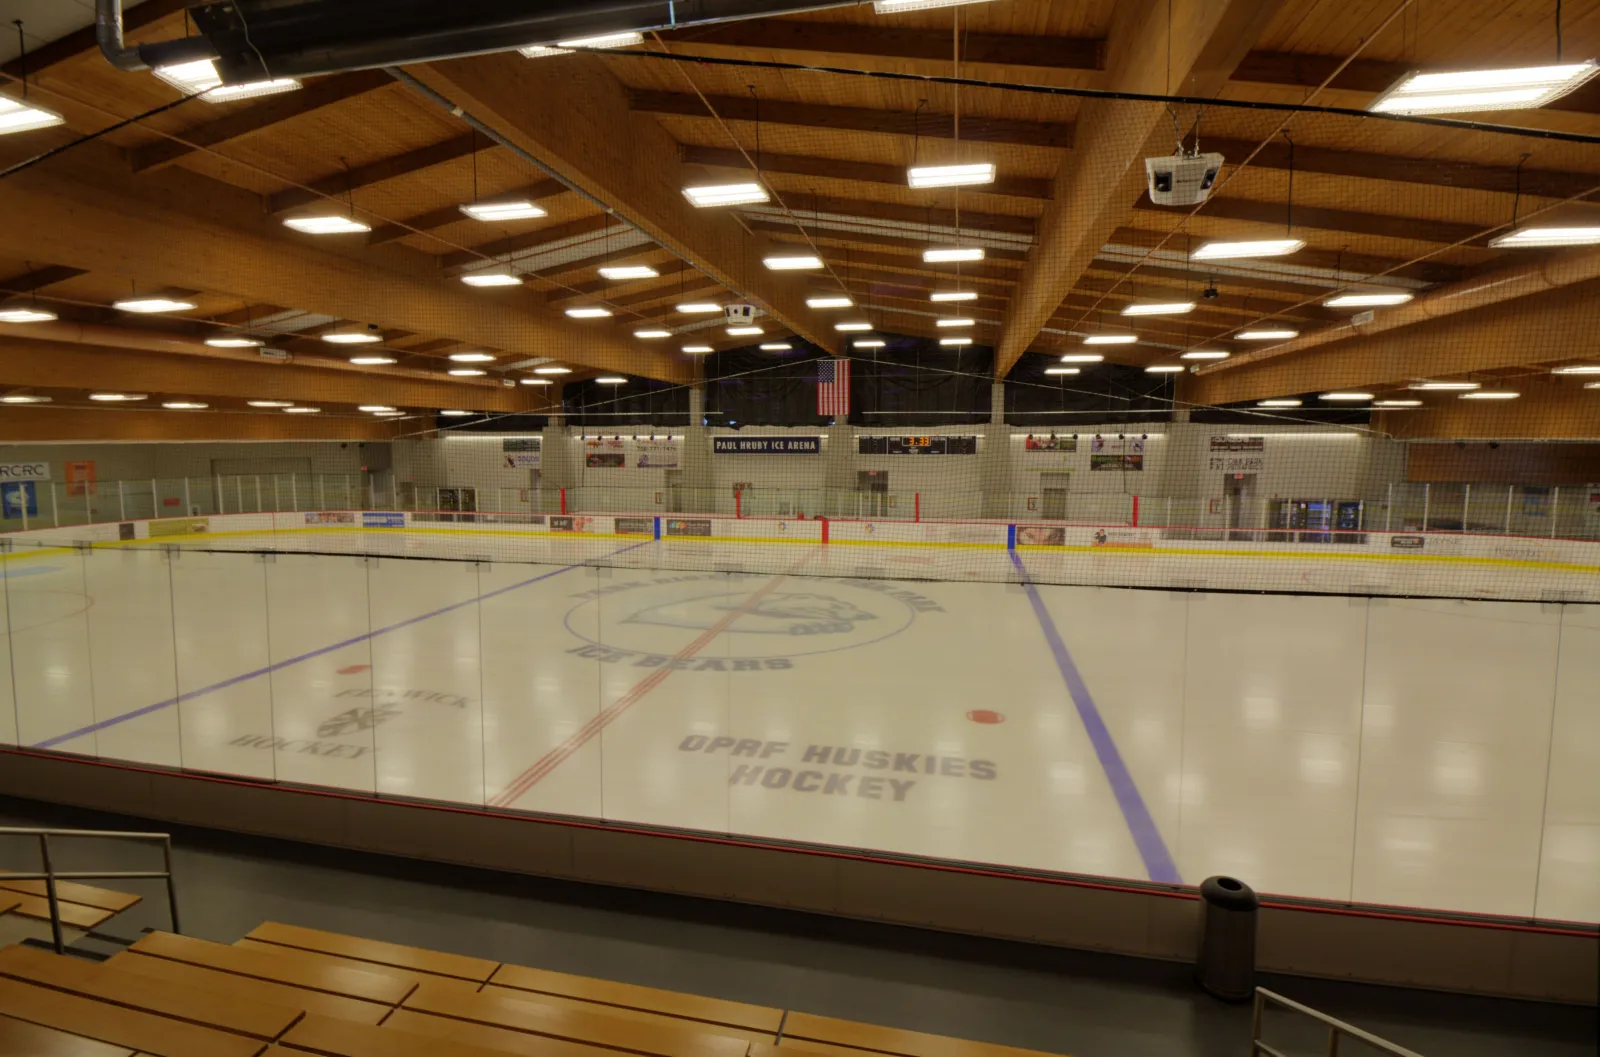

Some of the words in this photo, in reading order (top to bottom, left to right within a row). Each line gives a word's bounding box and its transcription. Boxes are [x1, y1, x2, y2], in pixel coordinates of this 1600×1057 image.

[716, 441, 737, 450] PAUL
[740, 441, 768, 450] HRUBY
[771, 441, 784, 450] ICE
[787, 441, 815, 450] ARENA
[566, 644, 636, 663] ICE
[633, 654, 794, 672] BEARS
[229, 734, 377, 759] HOCKEY
[680, 734, 789, 759] OPRF
[801, 745, 997, 780] HUSKIES
[728, 764, 917, 802] HOCKEY
